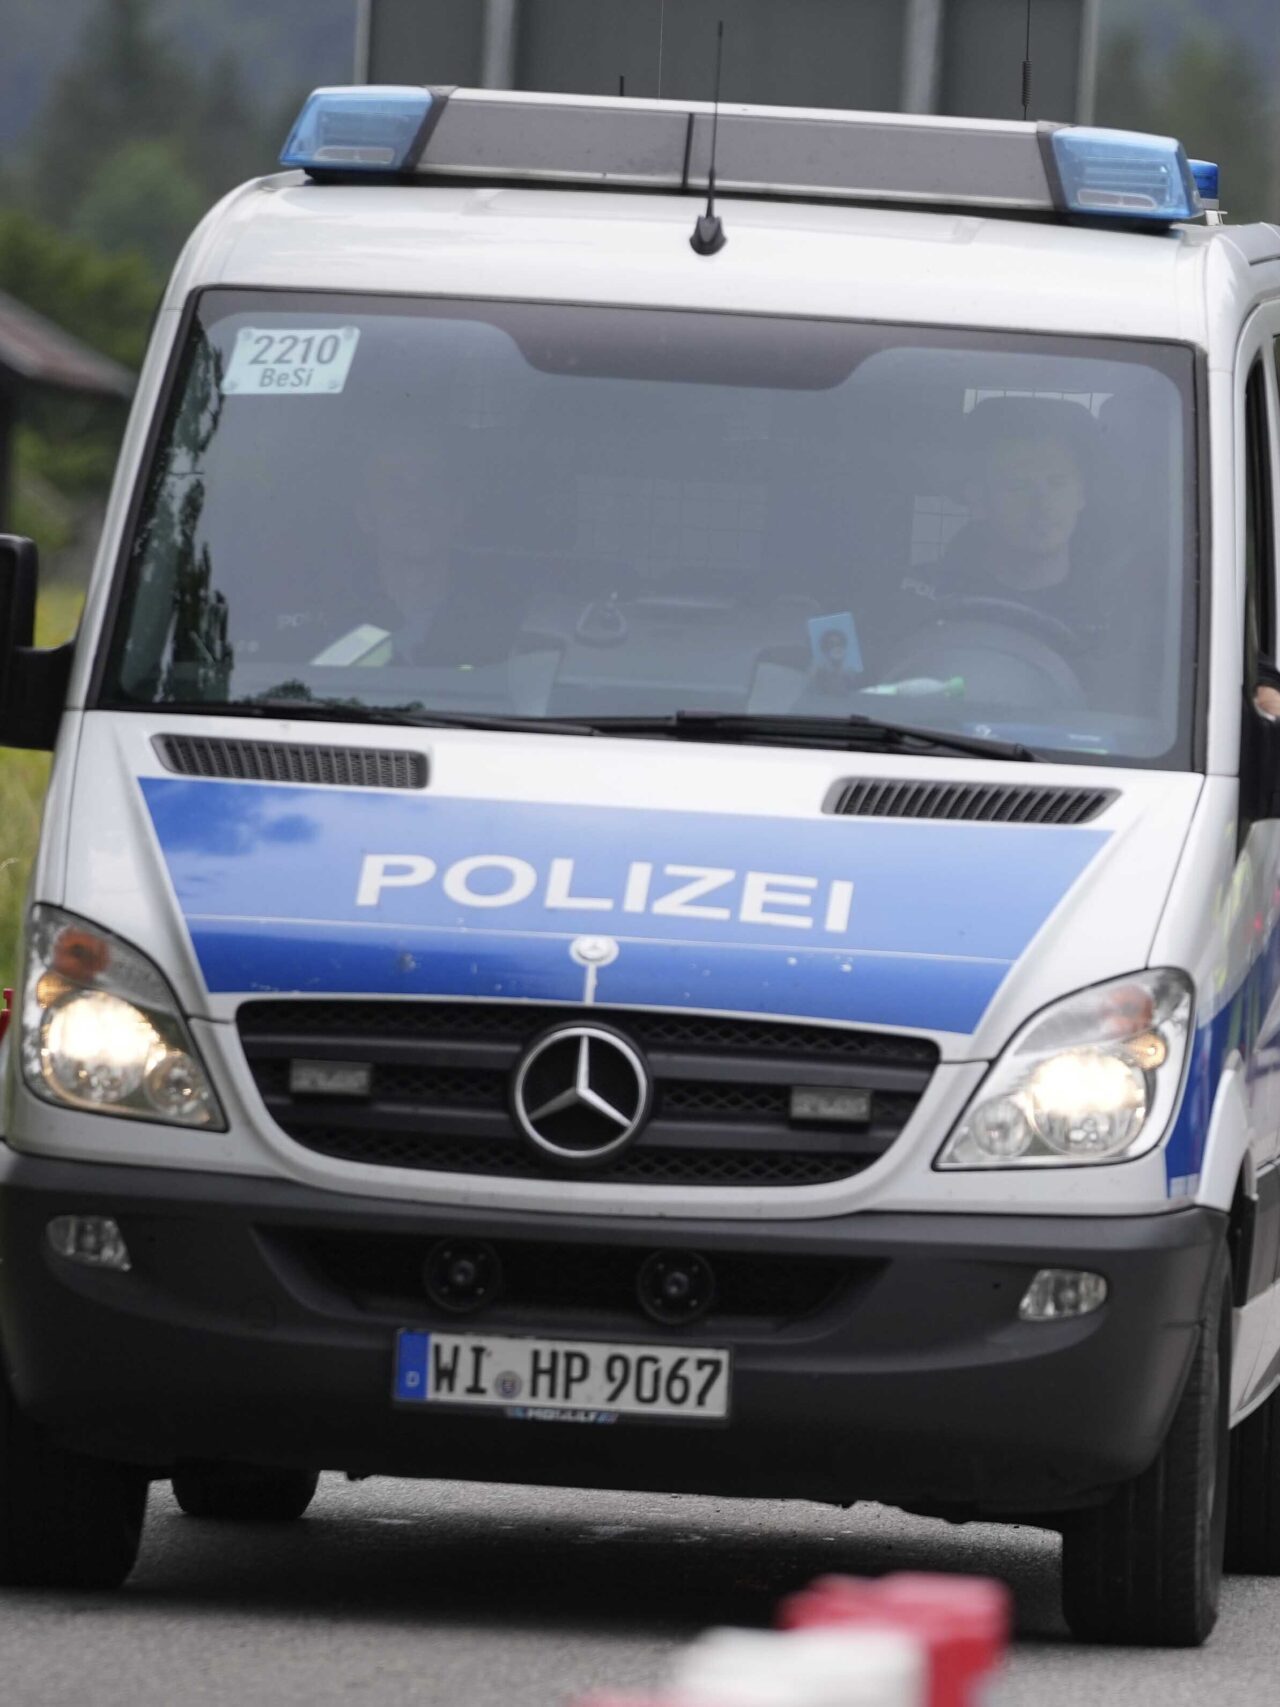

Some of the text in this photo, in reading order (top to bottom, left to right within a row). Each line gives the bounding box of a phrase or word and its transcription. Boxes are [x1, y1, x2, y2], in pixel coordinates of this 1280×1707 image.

[248, 334, 341, 365] 2210
[258, 367, 315, 388] BeSi
[355, 853, 855, 934] POLIZEI
[433, 1343, 723, 1407] WI HP 9067
